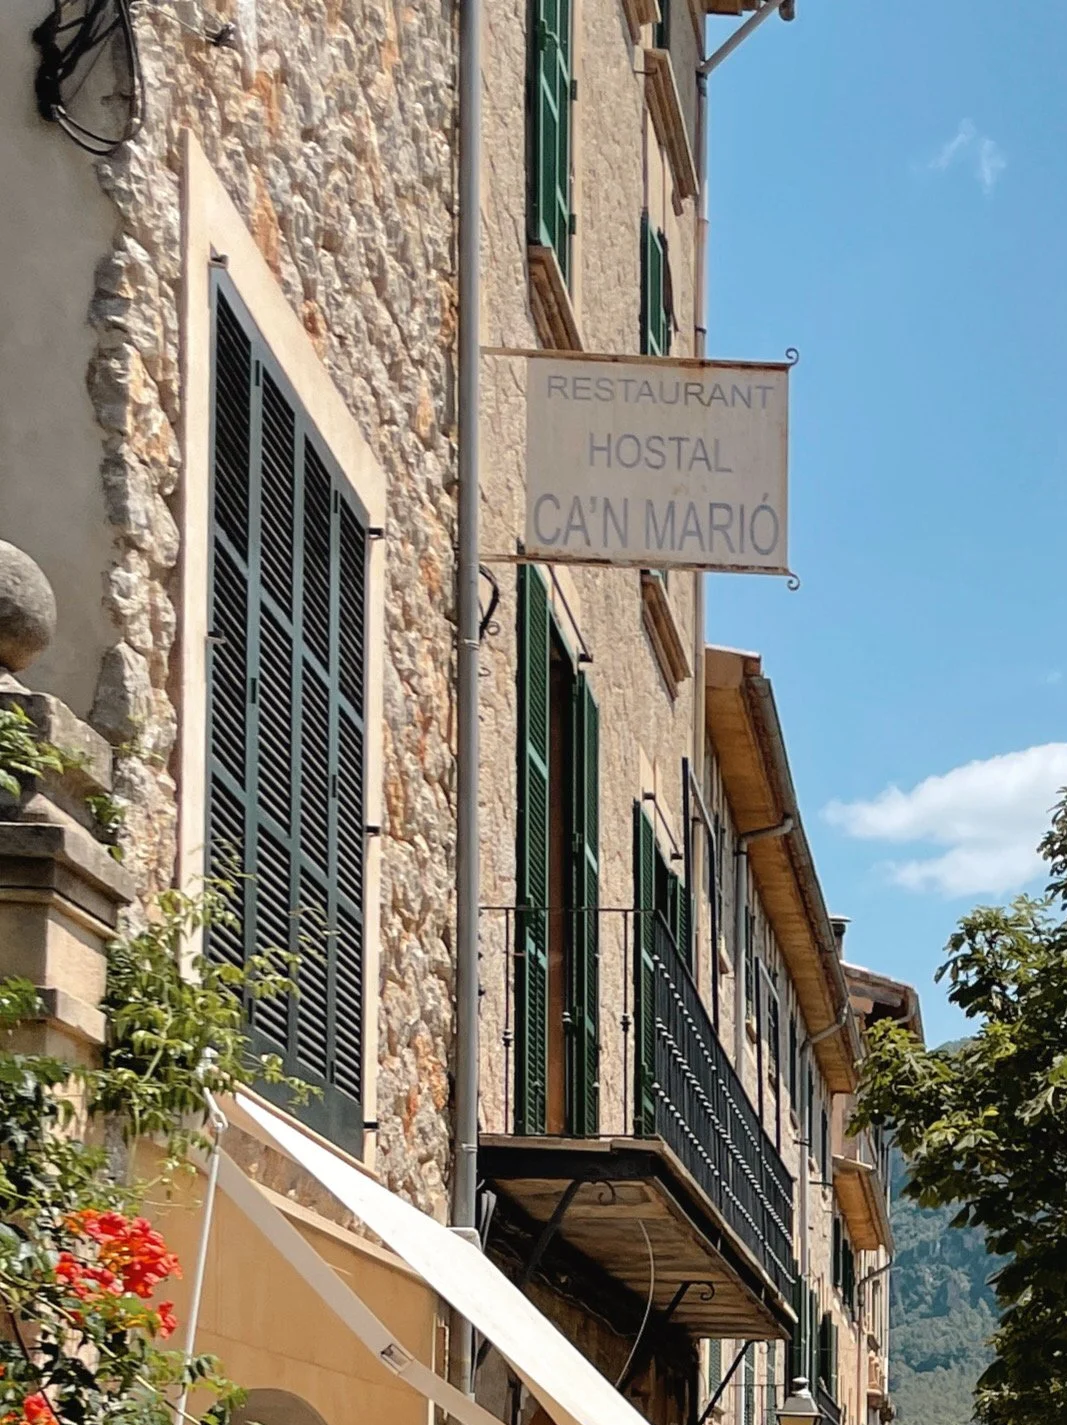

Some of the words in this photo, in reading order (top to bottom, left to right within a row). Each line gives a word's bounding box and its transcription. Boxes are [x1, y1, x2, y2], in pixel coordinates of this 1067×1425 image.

[547, 375, 774, 409] RESTAURANT
[589, 432, 733, 474] HOSTAL
[533, 493, 630, 550] CA'N
[645, 493, 780, 556] MARIÓ
